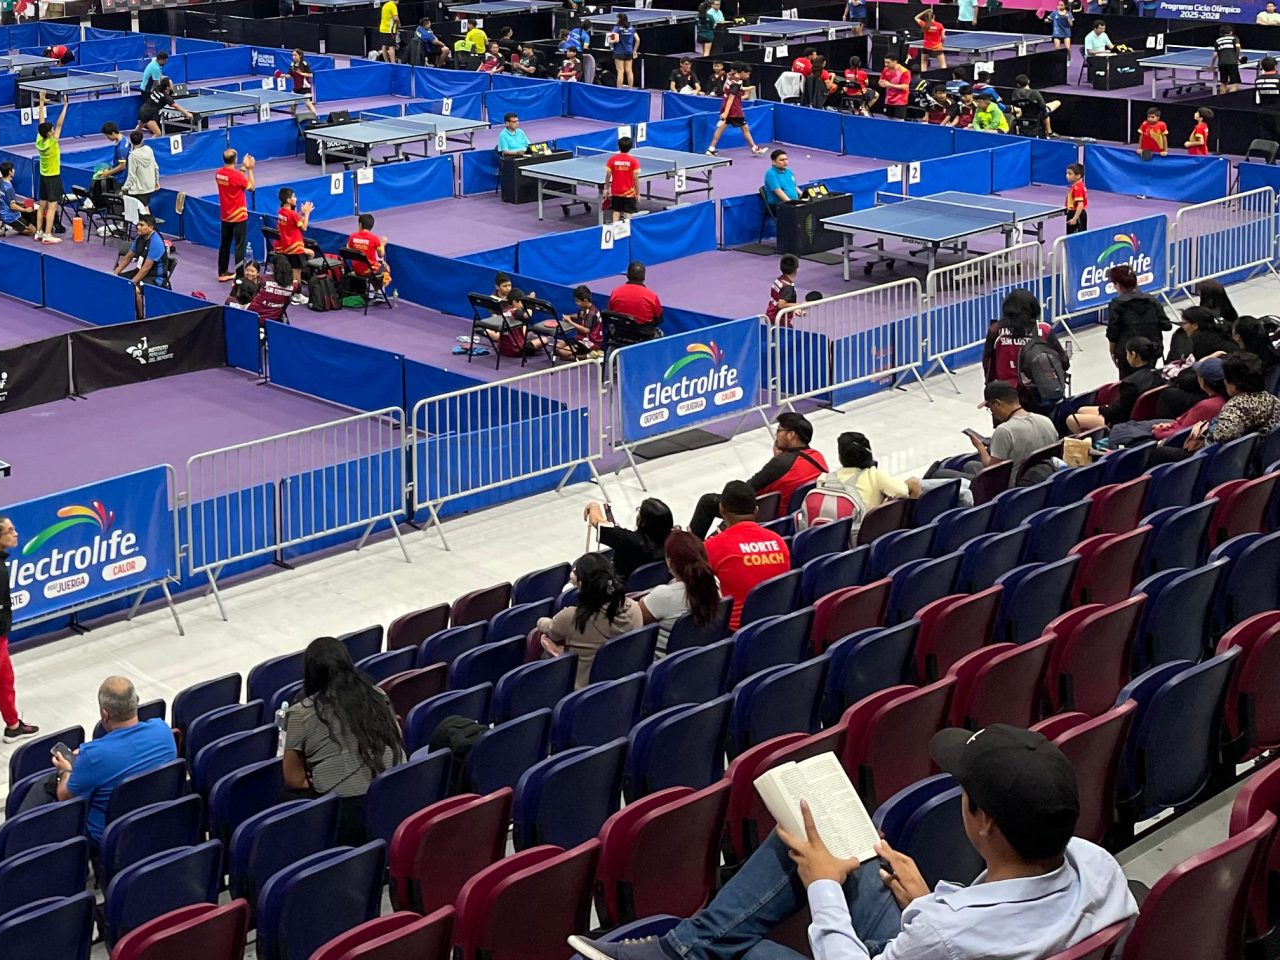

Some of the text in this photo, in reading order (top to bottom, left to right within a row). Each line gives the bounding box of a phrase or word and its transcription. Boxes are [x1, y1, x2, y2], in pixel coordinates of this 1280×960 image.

[1160, 2, 1241, 14] Programa Ciclo Olímpico
[1180, 11, 1220, 19] 2025-2028
[173, 139, 180, 151] 0
[438, 135, 444, 148] 8
[911, 167, 918, 179] 2
[334, 178, 341, 189] 0
[677, 175, 684, 188] 5
[605, 230, 611, 243] 0
[1080, 253, 1151, 287] Eleclife
[642, 364, 738, 410] Electrolife
[739, 540, 780, 554] NORTE
[5, 529, 136, 589] lectrolife
[743, 552, 785, 566] COACH
[57, 576, 86, 593] JUERGA
[113, 561, 136, 576] CALOR
